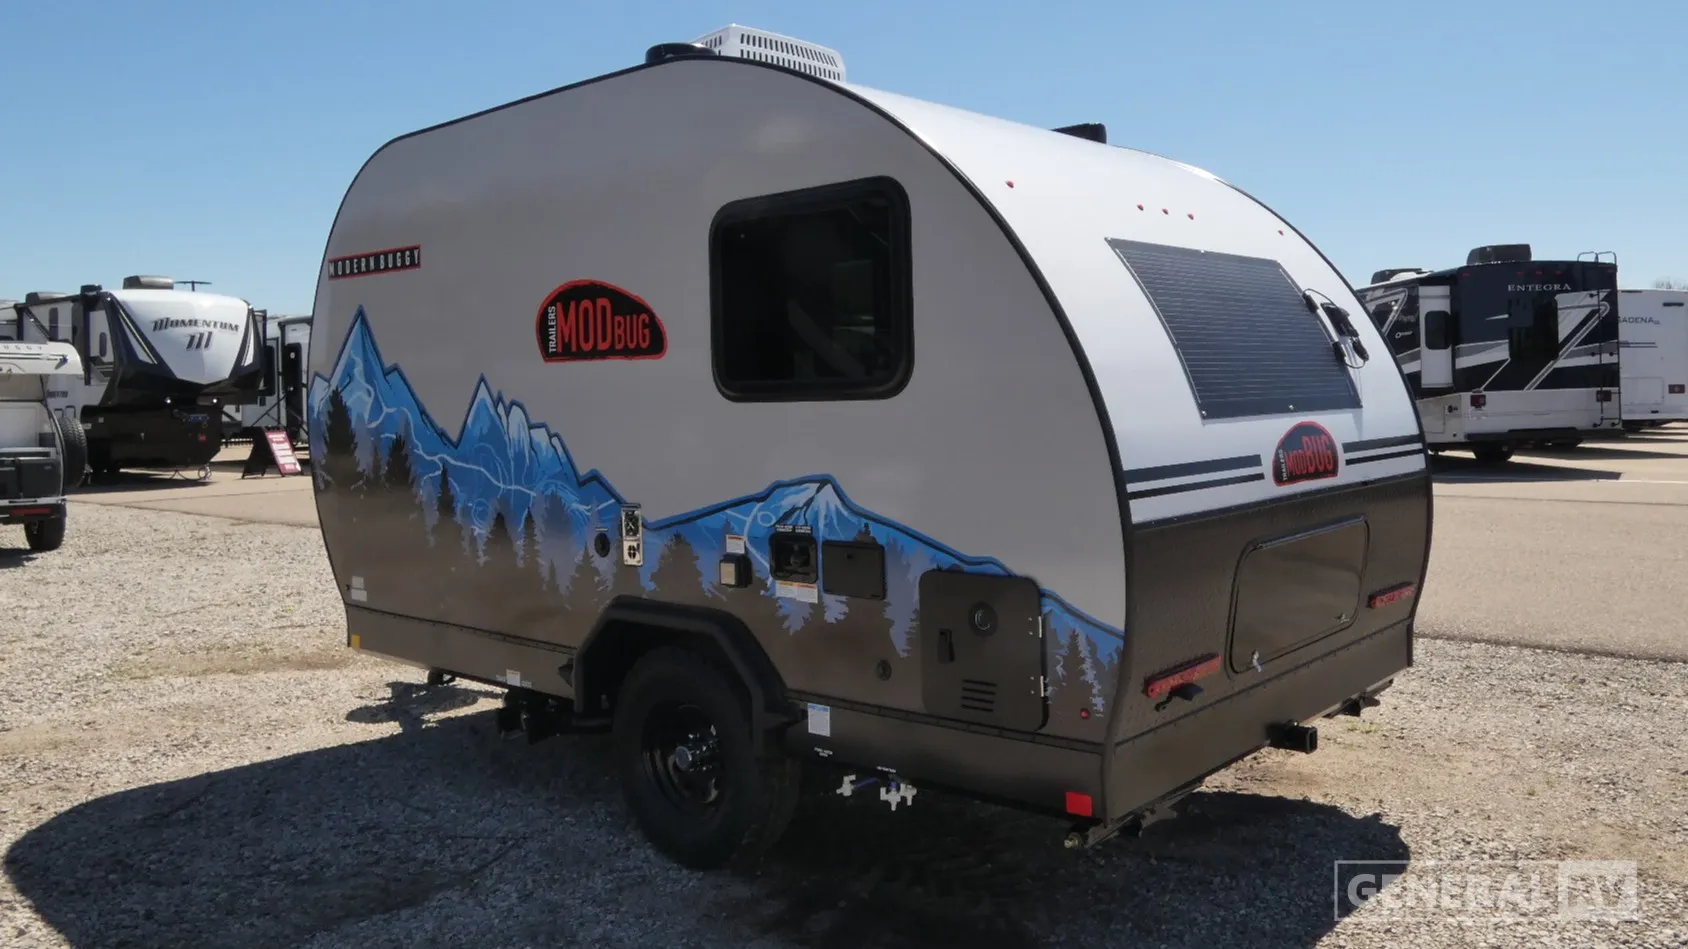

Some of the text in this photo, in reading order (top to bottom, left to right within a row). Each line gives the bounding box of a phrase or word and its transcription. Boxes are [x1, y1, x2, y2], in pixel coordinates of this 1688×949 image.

[328, 248, 419, 276] MODERN BUGGY
[1507, 283, 1572, 292] ENTEGRA
[548, 306, 557, 353] TRAILERS
